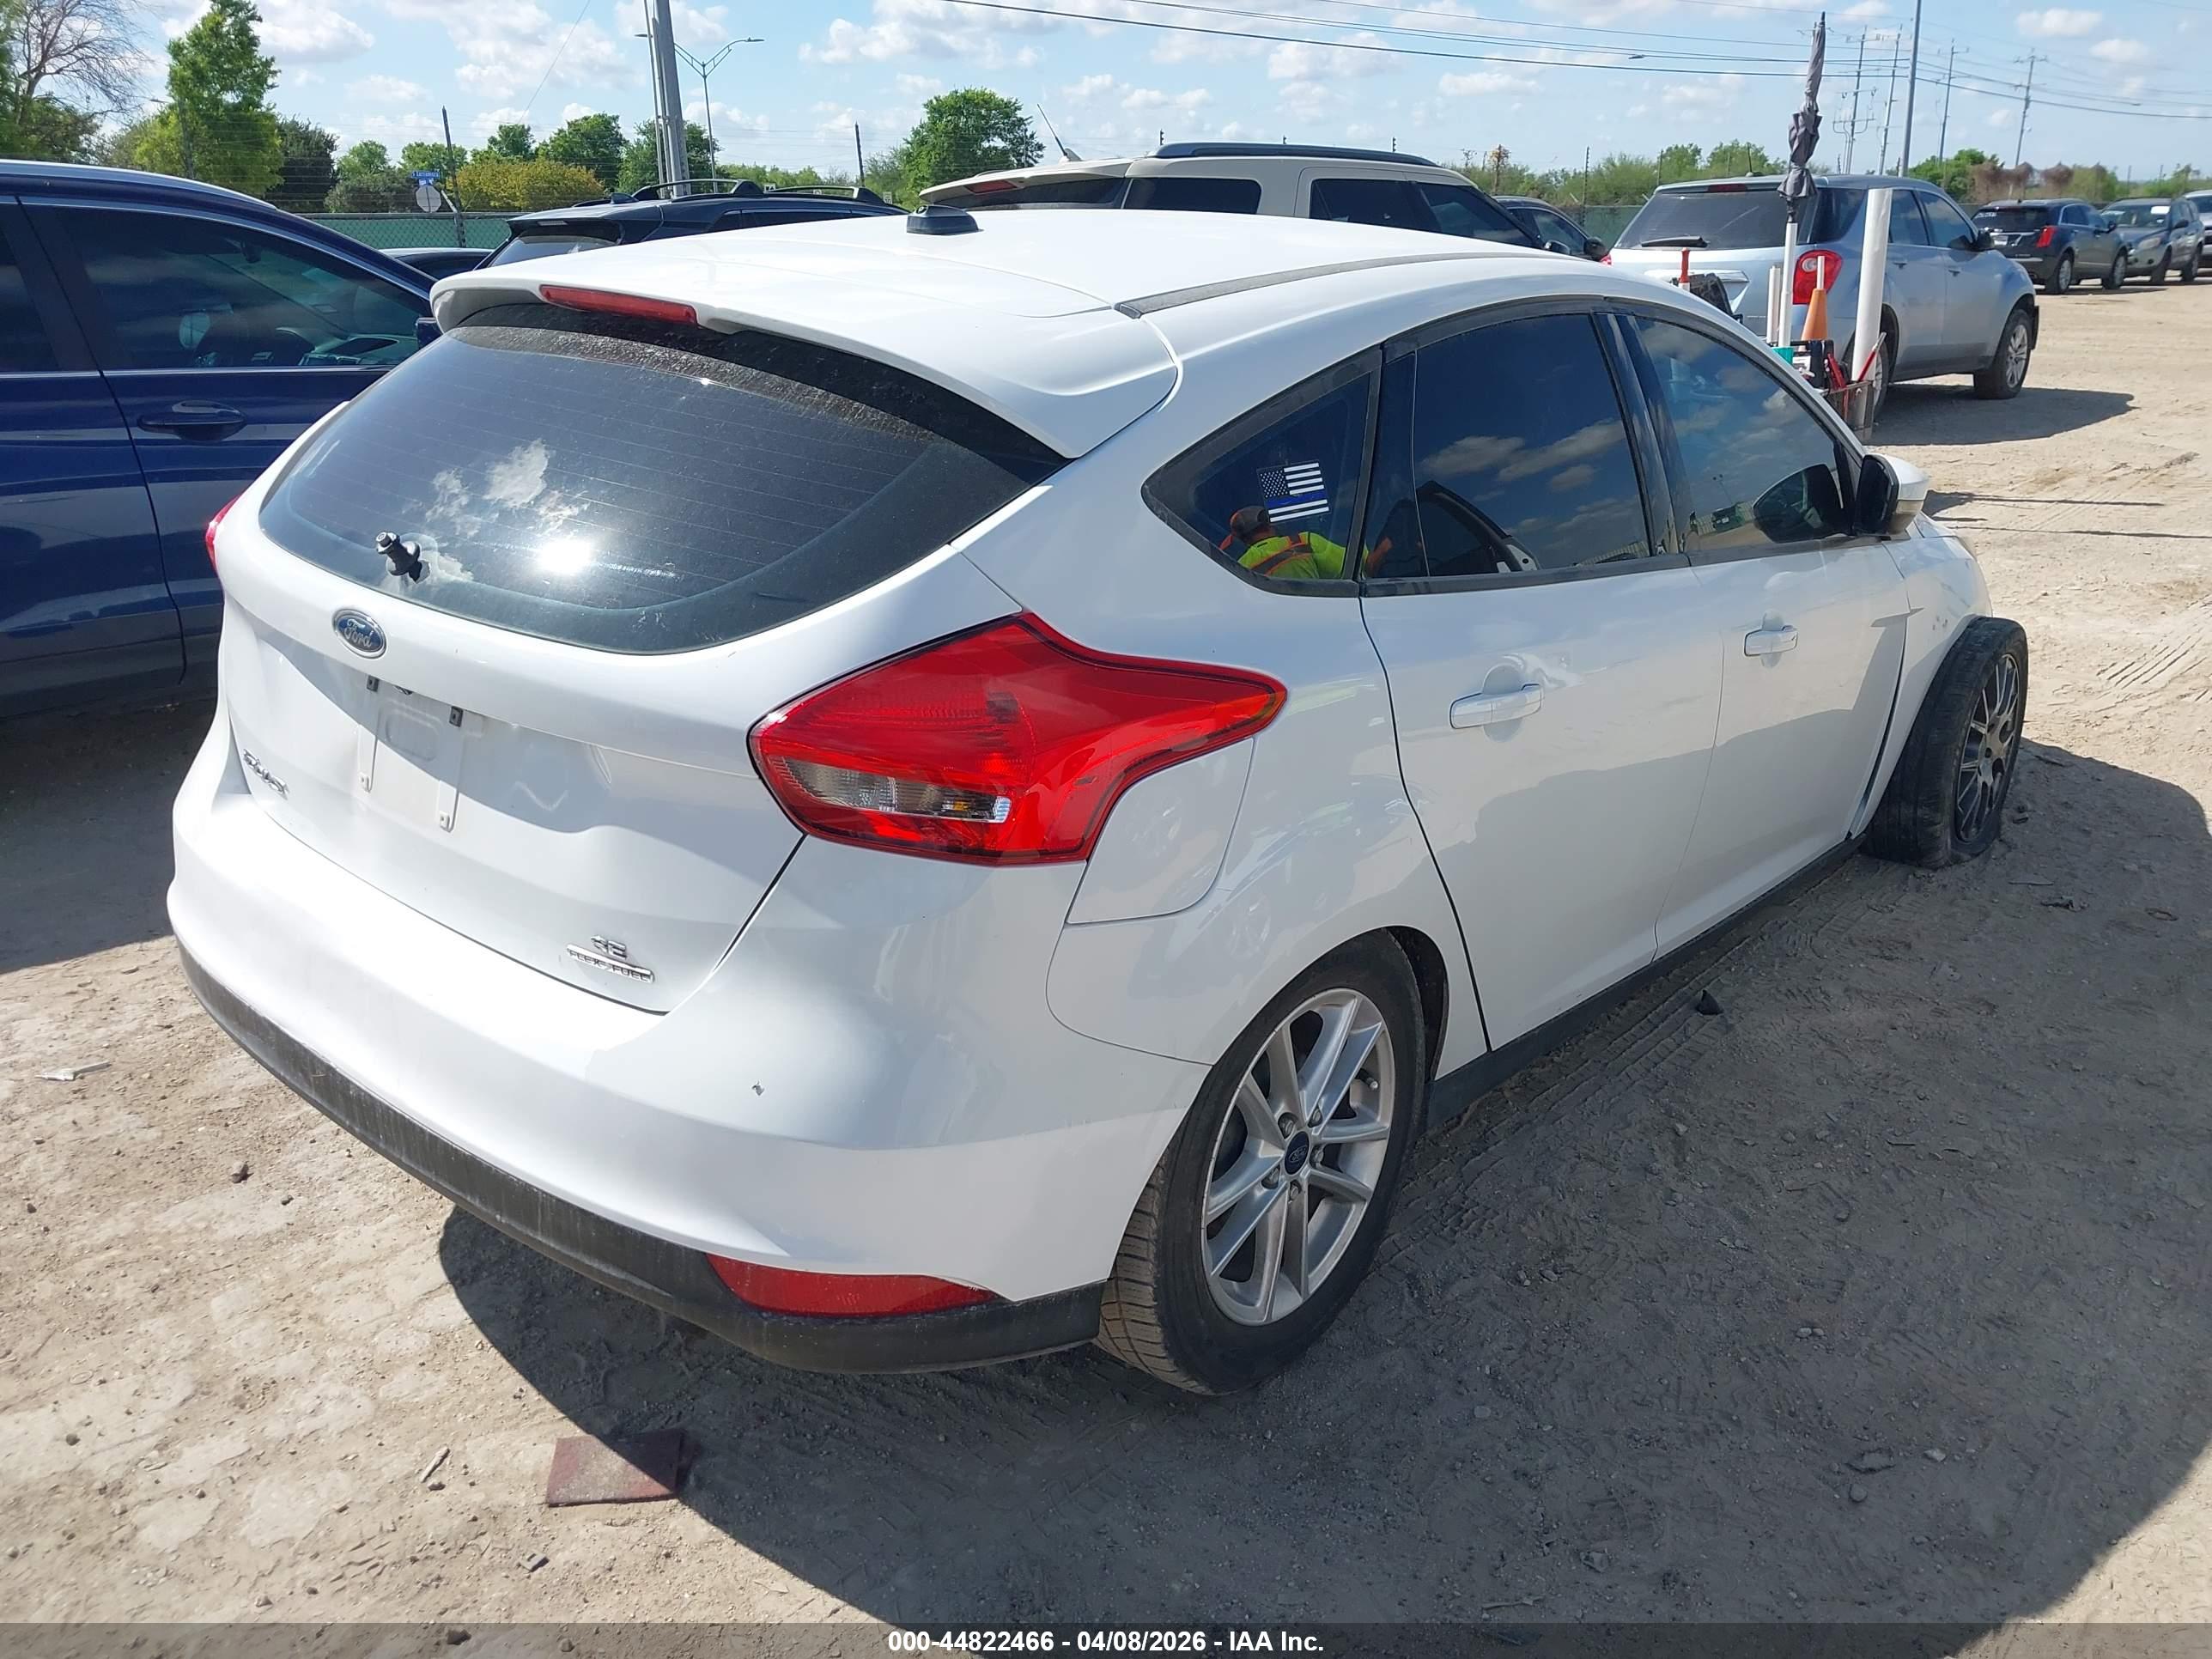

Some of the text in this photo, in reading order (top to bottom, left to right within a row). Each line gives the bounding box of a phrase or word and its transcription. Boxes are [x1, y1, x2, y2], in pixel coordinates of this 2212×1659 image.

[344, 618, 374, 647] Ford
[591, 935, 628, 959] SE
[612, 964, 652, 982] FUEL
